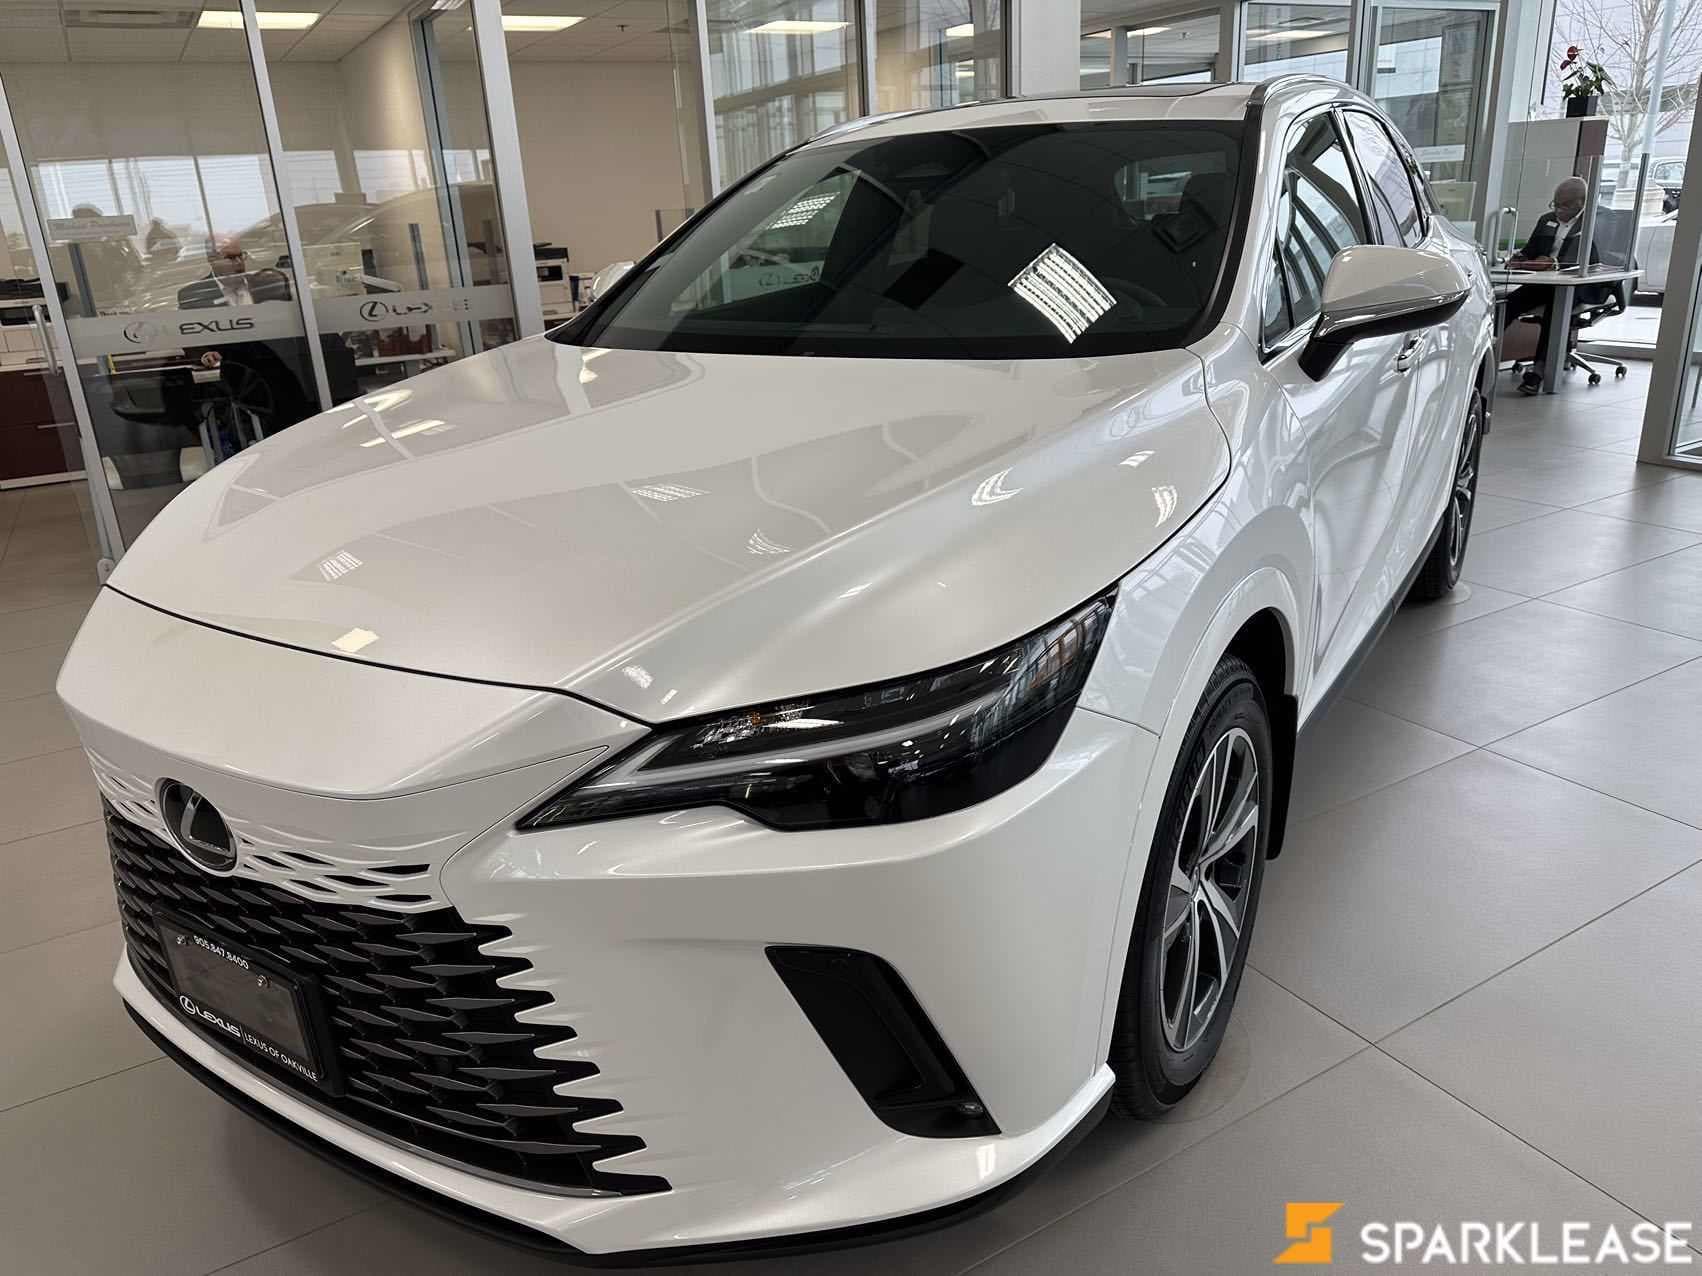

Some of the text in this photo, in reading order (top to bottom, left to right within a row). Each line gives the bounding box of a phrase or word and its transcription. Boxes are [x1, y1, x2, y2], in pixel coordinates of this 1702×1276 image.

[166, 318, 255, 335] EXUS
[196, 1006, 241, 1037] LEXUS
[245, 1033, 318, 1082] LEXUS OF OAKVILLE
